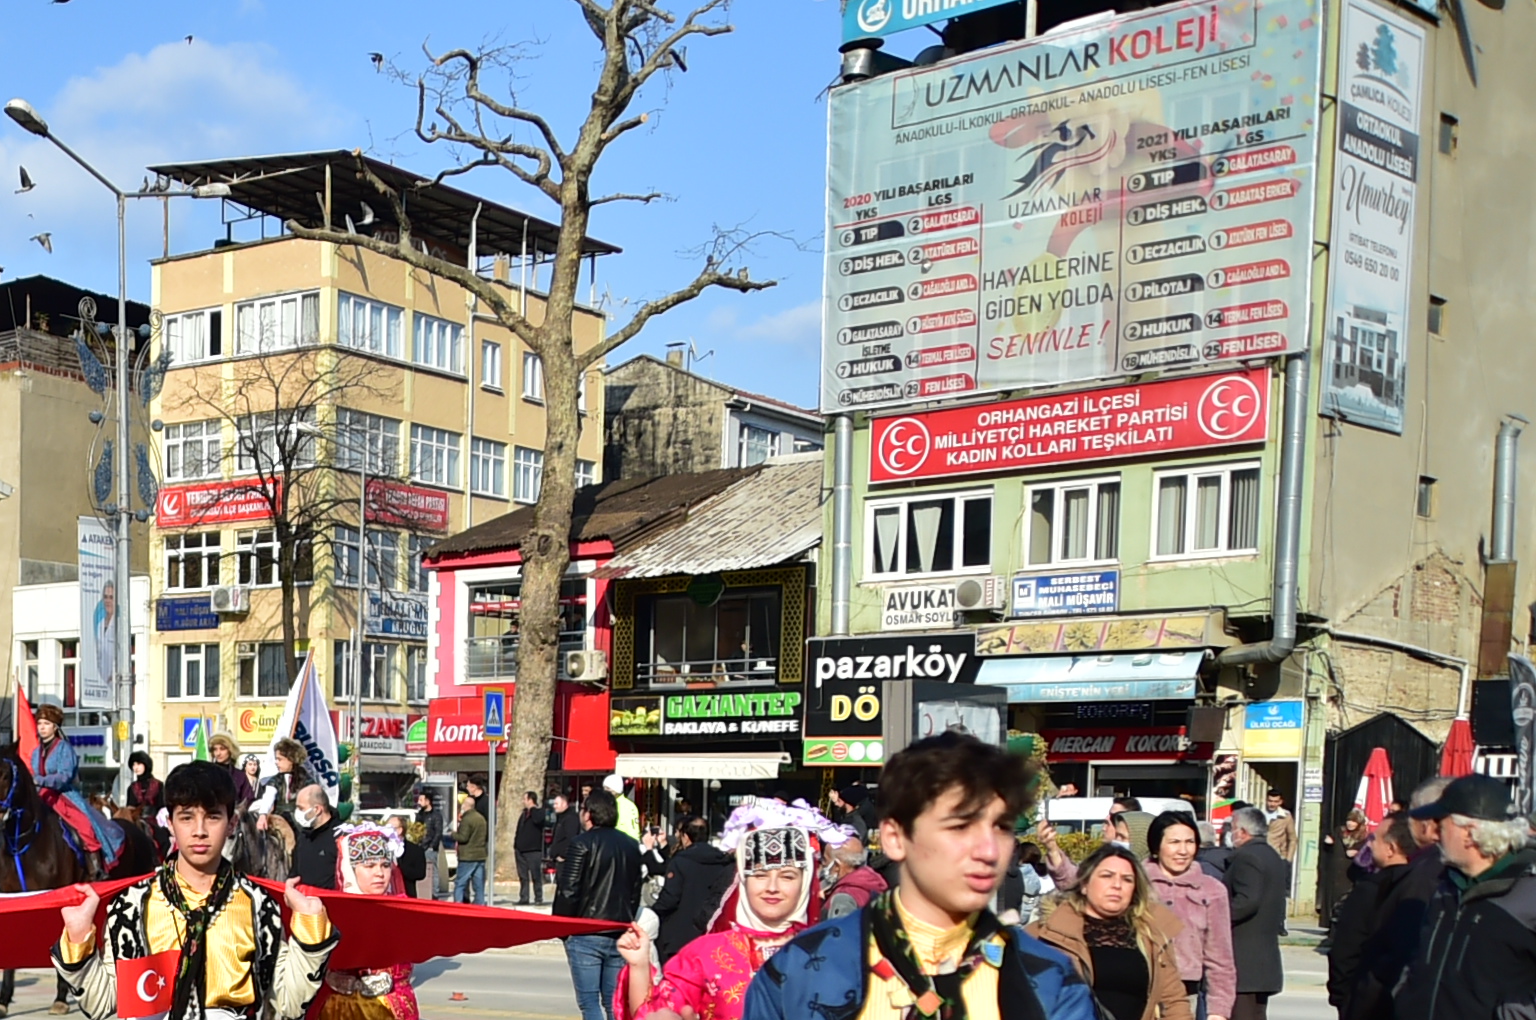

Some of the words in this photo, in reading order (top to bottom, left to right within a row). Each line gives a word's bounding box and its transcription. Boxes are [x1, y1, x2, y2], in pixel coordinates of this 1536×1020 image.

[925, 43, 1100, 108] UZMANLAR
[1108, 5, 1220, 65] KOLEJİ
[1079, 80, 1136, 105] ANADOLU
[1210, 54, 1251, 77] LİSESİ
[1137, 133, 1169, 149] 2021
[1173, 126, 1198, 142] YILI
[1201, 107, 1291, 136] BAŞARILARI
[1356, 111, 1402, 147] ORTAOKUL
[1149, 148, 1177, 163] YKS
[1237, 130, 1264, 146] LGS
[1343, 133, 1385, 166] ANADOLU
[1385, 148, 1412, 178] LİSESİ
[1215, 161, 1225, 173] 2
[1229, 148, 1293, 171] GALATASARAY
[843, 193, 871, 208] 2020
[874, 188, 896, 202] YILI
[898, 173, 974, 197] BAŞARILARI
[1132, 177, 1143, 190] 9
[1151, 170, 1175, 186] TIP
[855, 207, 878, 221] YKS
[928, 193, 952, 207] LGS
[1009, 188, 1101, 218] UZMANLAR
[1061, 203, 1102, 227] KOLEJİ
[1146, 203, 1170, 221] DİŞ
[1172, 199, 1205, 216] HEK.
[1341, 165, 1409, 235] Umurbey
[843, 231, 853, 243] 6
[860, 227, 878, 241] TIP
[1145, 238, 1205, 259] ECZACILIK
[854, 256, 874, 274] DİŞ
[876, 253, 904, 267] HEK.
[983, 251, 1114, 291] HAYALLERİNE
[854, 289, 899, 306] ECZACILIK
[1144, 279, 1191, 298] PİLOTAJ
[986, 294, 1042, 320] GİDEN
[1048, 283, 1114, 310] YOLDA
[1142, 318, 1192, 336] HUKUK
[1207, 312, 1222, 326] 14
[987, 323, 1095, 360] SENİNLE
[1204, 345, 1219, 357] 25
[1222, 340, 1244, 354] FEN
[1246, 333, 1282, 351] LİSESİ
[853, 358, 895, 375] HUKUK
[1125, 356, 1137, 369] 18
[925, 380, 942, 394] FEN
[943, 375, 966, 391] LİSESİ
[977, 397, 1079, 427] ORHANGAZİ
[1083, 390, 1140, 415] İLÇESİ
[934, 422, 1025, 450] MİLLİYETÇİ
[1029, 415, 1112, 438] HAREKET
[1117, 402, 1189, 427] PARTİSİ
[946, 446, 997, 466] KADIN
[1001, 437, 1077, 460] KOLLARI
[1081, 426, 1173, 452] TEŞKİLATI
[1038, 581, 1114, 594] MUHASEBECİ
[1050, 574, 1101, 585] SERBEST
[1038, 593, 1064, 608] MALİ
[1066, 591, 1114, 607] MÜŞAVİR
[886, 610, 922, 625] OSMAN
[815, 645, 967, 688] pazarköy
[665, 721, 727, 735] BAKLAVA
[728, 721, 739, 732] &
[1051, 735, 1116, 753] MERCAN
